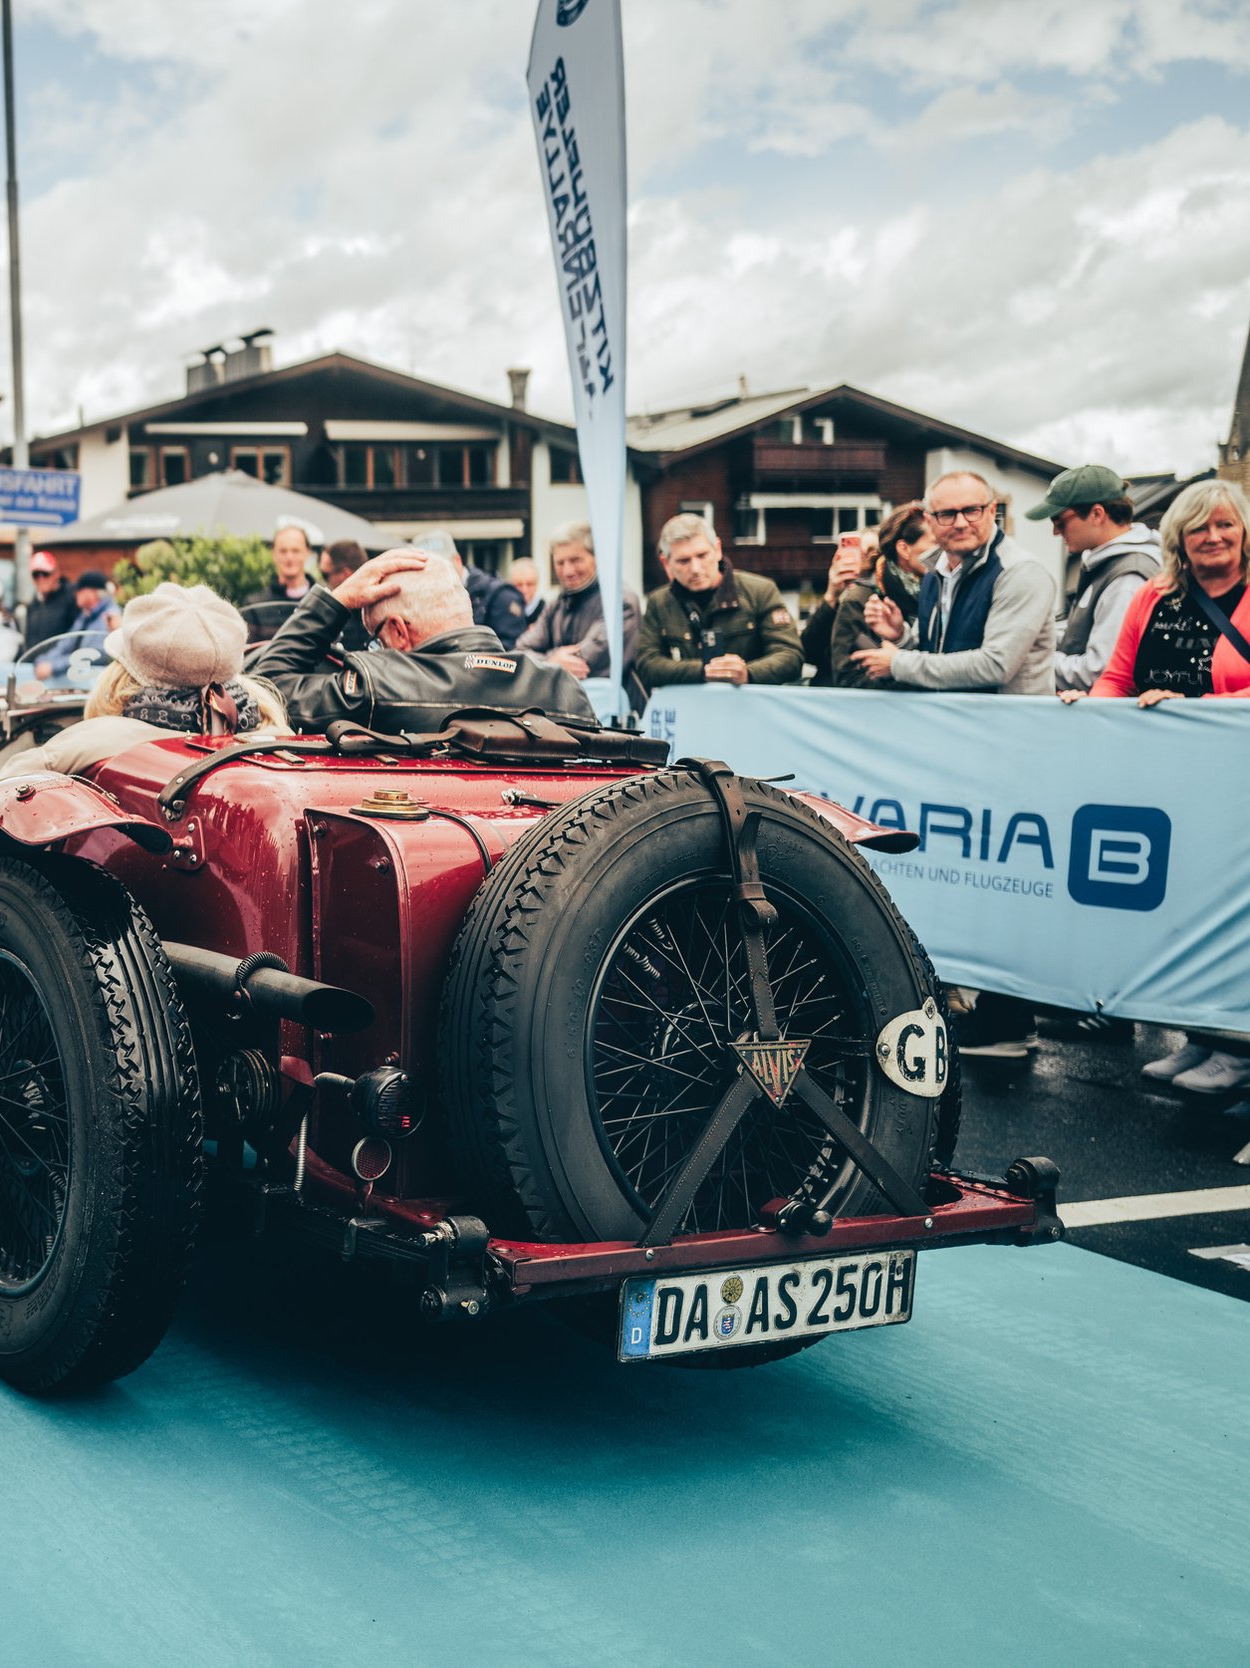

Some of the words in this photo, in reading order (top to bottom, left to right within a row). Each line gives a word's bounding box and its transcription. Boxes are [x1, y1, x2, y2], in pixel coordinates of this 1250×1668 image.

[476, 658, 515, 670] DUNLOP
[928, 868, 961, 886] UND
[964, 871, 1055, 899] FLUGZEUGE
[752, 1048, 799, 1096] ALVIS
[896, 1023, 949, 1084] GB
[653, 1283, 709, 1346] DA
[745, 1272, 801, 1335] AS
[807, 1256, 913, 1326] 250H
[631, 1327, 643, 1345] D
